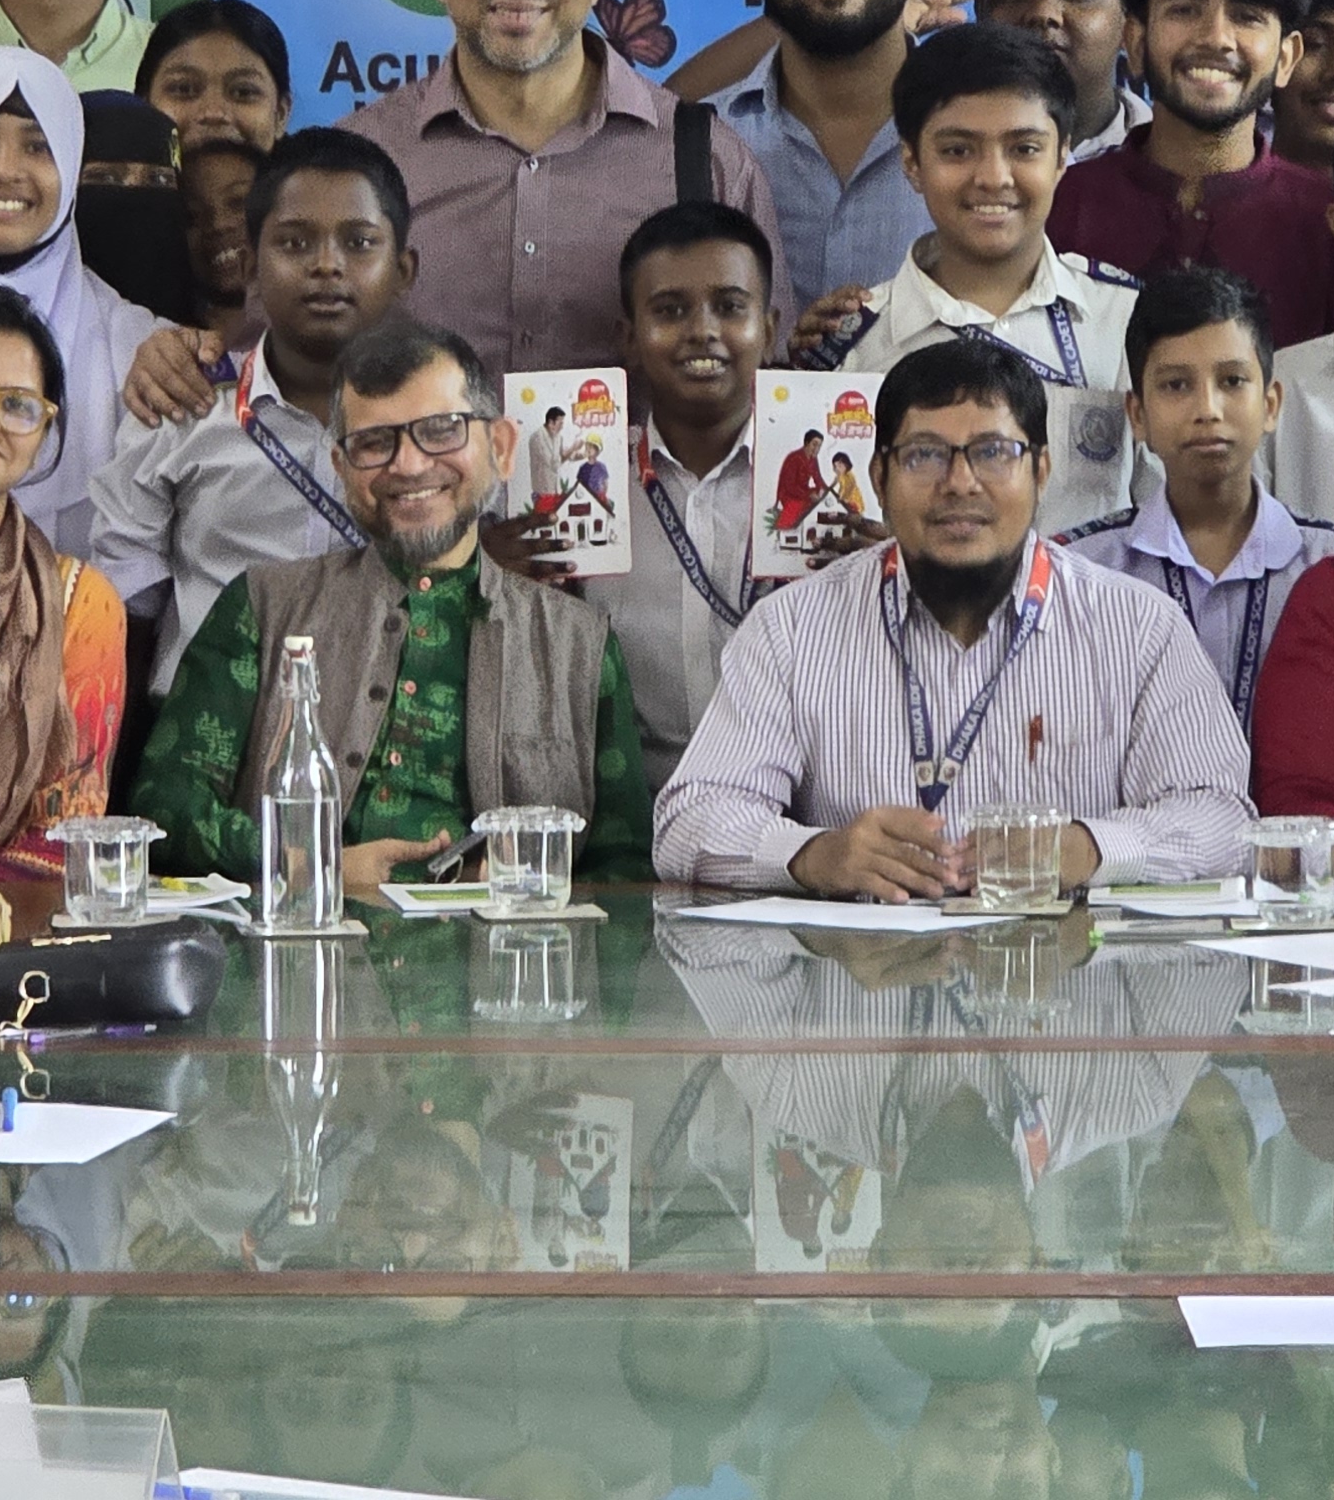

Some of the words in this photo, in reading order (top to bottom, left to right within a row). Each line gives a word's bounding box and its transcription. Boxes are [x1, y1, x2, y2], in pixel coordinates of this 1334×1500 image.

[1055, 318, 1077, 361] CADET
[1019, 355, 1049, 377] IDE
[248, 422, 291, 468] SCHOOL
[285, 463, 320, 501] CADET
[648, 485, 678, 531] SCHOOL
[342, 523, 368, 550] AKA
[670, 529, 697, 567] CADET
[1250, 578, 1266, 620] SCHOO
[1243, 620, 1259, 661] CADET
[952, 711, 980, 760] DHAKA
[1009, 600, 1040, 652] SCHOOL
[1238, 663, 1253, 698] IDEAL
[911, 707, 926, 755] DHAKA
